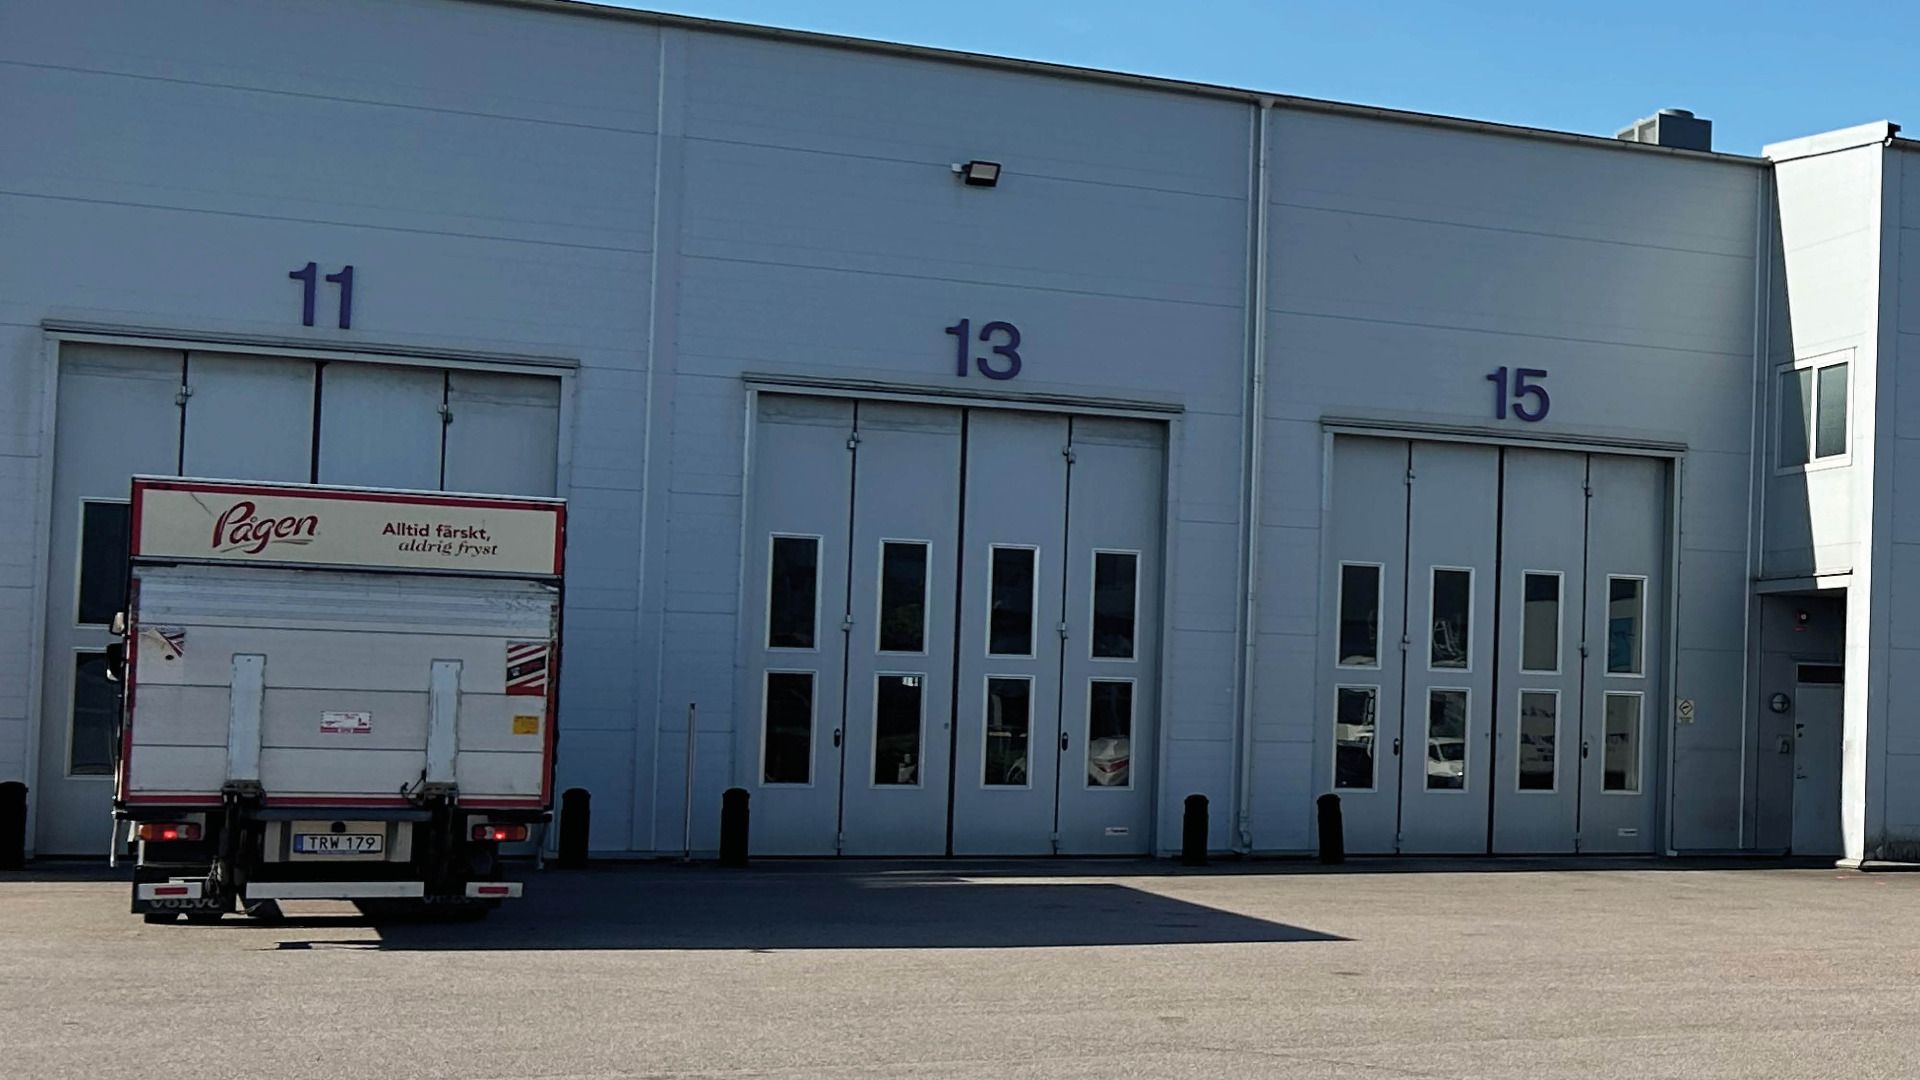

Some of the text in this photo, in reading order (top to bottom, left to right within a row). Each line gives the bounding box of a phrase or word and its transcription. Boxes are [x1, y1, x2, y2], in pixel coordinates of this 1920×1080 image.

[289, 261, 354, 329] 11
[945, 318, 1021, 380] 13
[1486, 366, 1551, 422] 15
[212, 501, 318, 554] Pågen
[382, 522, 429, 537] Alltid
[398, 539, 498, 557] aldrig fryst
[309, 837, 376, 849] TRW 179
